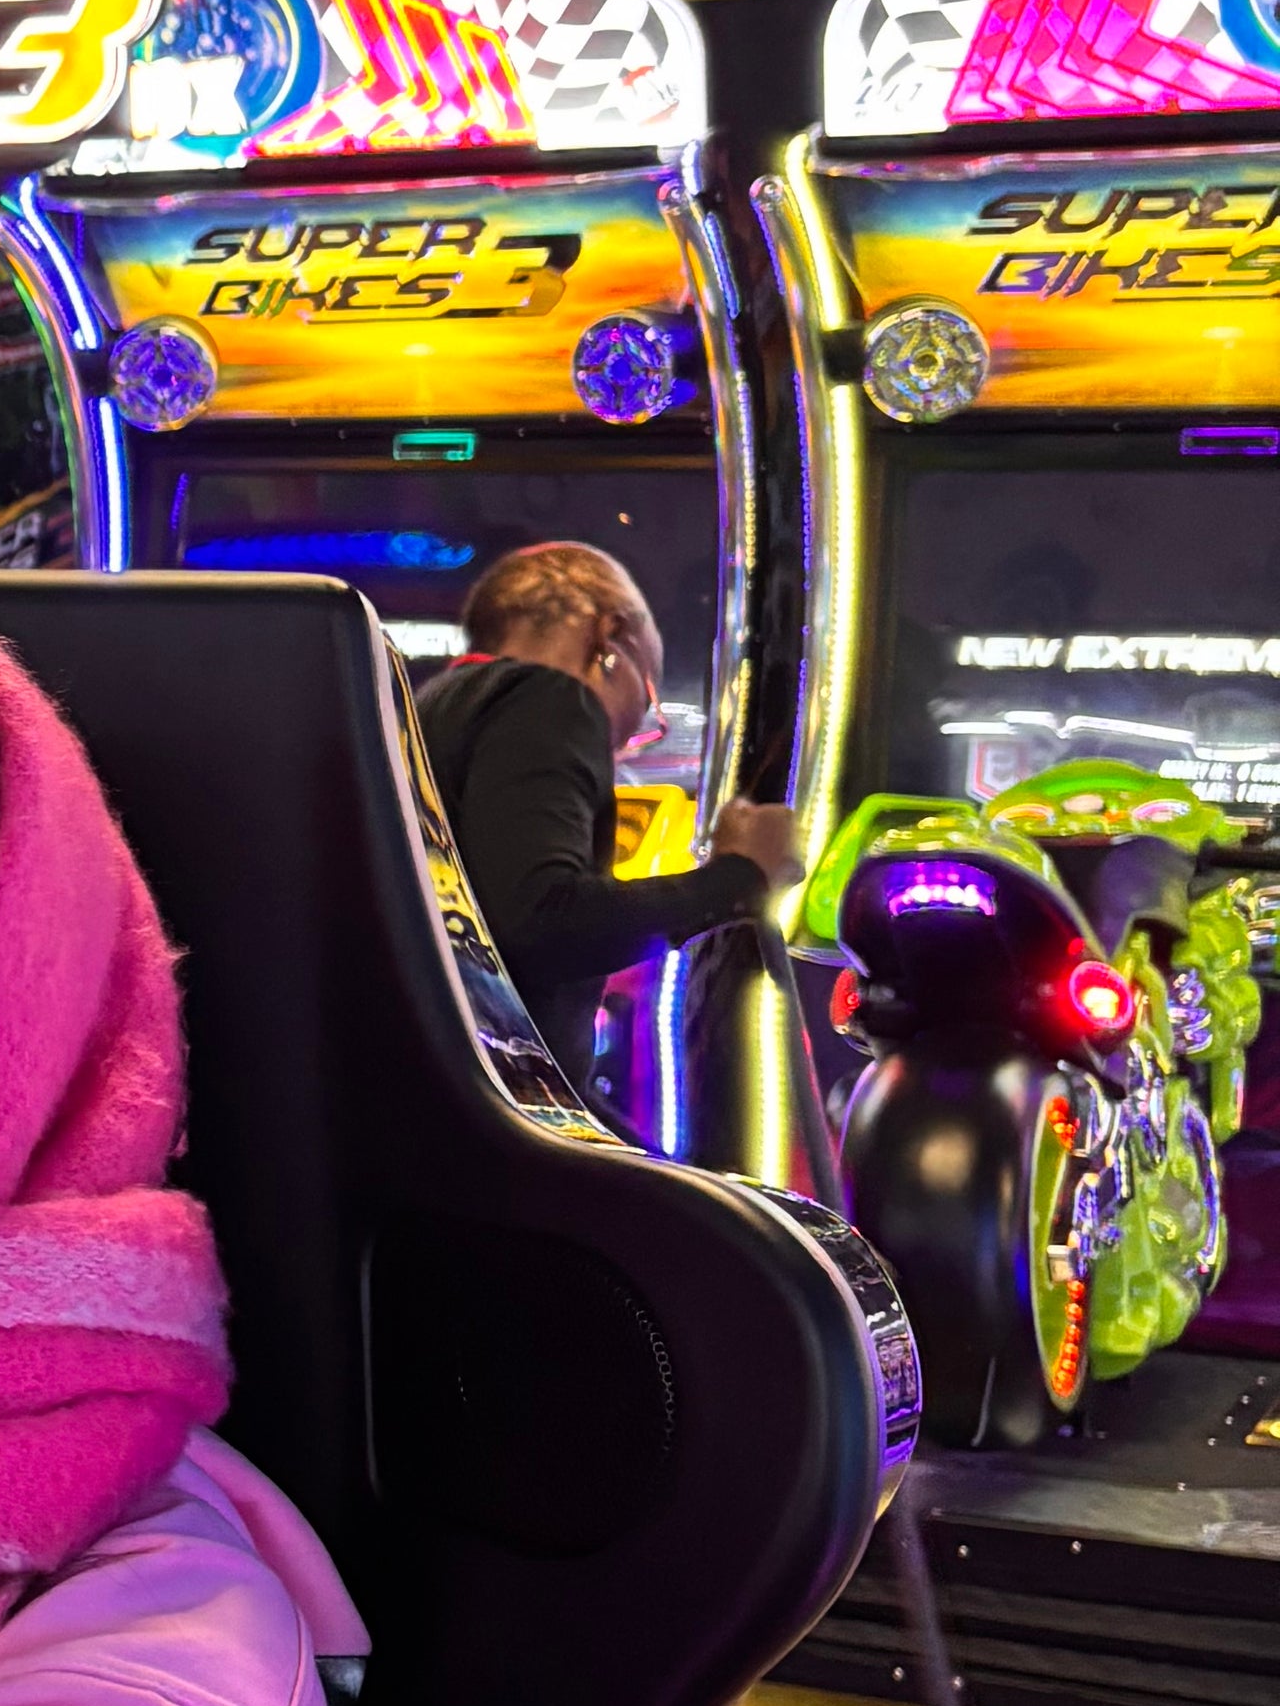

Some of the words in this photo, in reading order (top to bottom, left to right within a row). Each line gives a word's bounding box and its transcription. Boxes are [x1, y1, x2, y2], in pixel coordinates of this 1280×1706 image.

[183, 217, 487, 266] SUPER
[198, 271, 464, 318] BIKES
[495, 233, 582, 318] 3
[959, 635, 1065, 672] NEW
